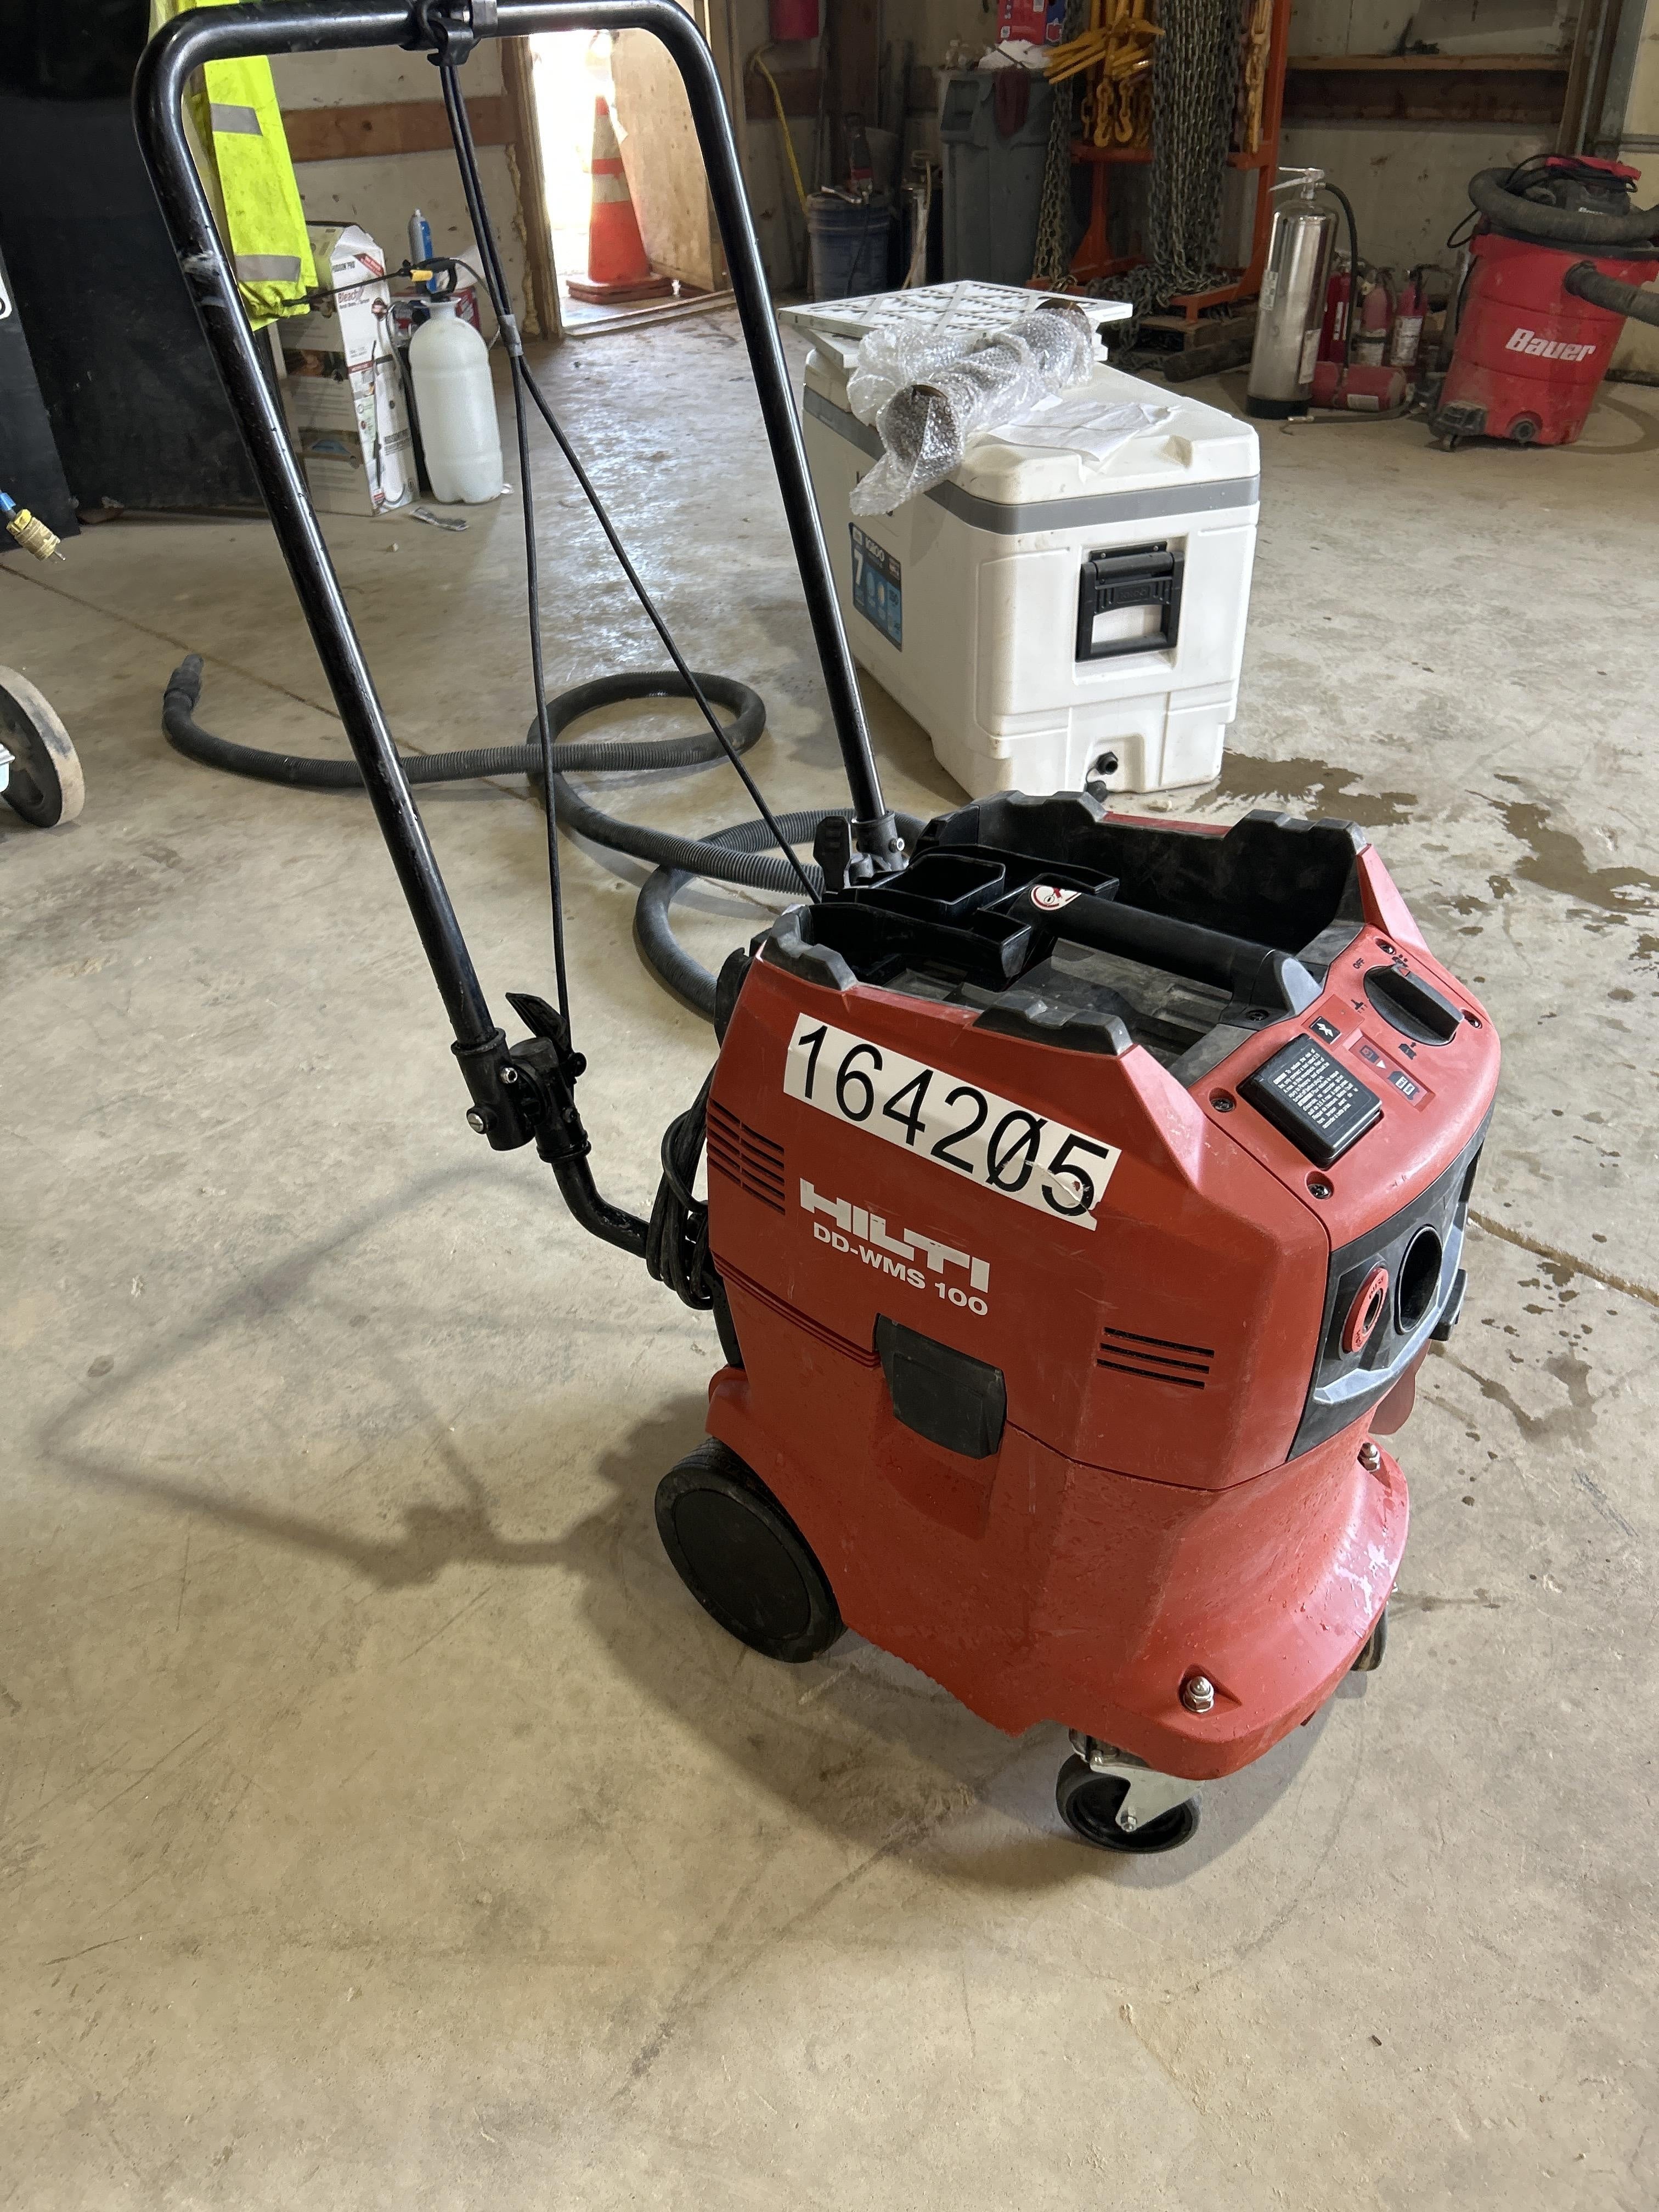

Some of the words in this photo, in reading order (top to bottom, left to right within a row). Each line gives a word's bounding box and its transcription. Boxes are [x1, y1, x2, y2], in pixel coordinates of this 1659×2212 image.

[1505, 328, 1596, 362] Bauer
[1352, 957, 1365, 969] OFF
[800, 1178, 990, 1294] HILTI
[814, 1222, 926, 1290] DD-WMS
[934, 1282, 988, 1316] 100
